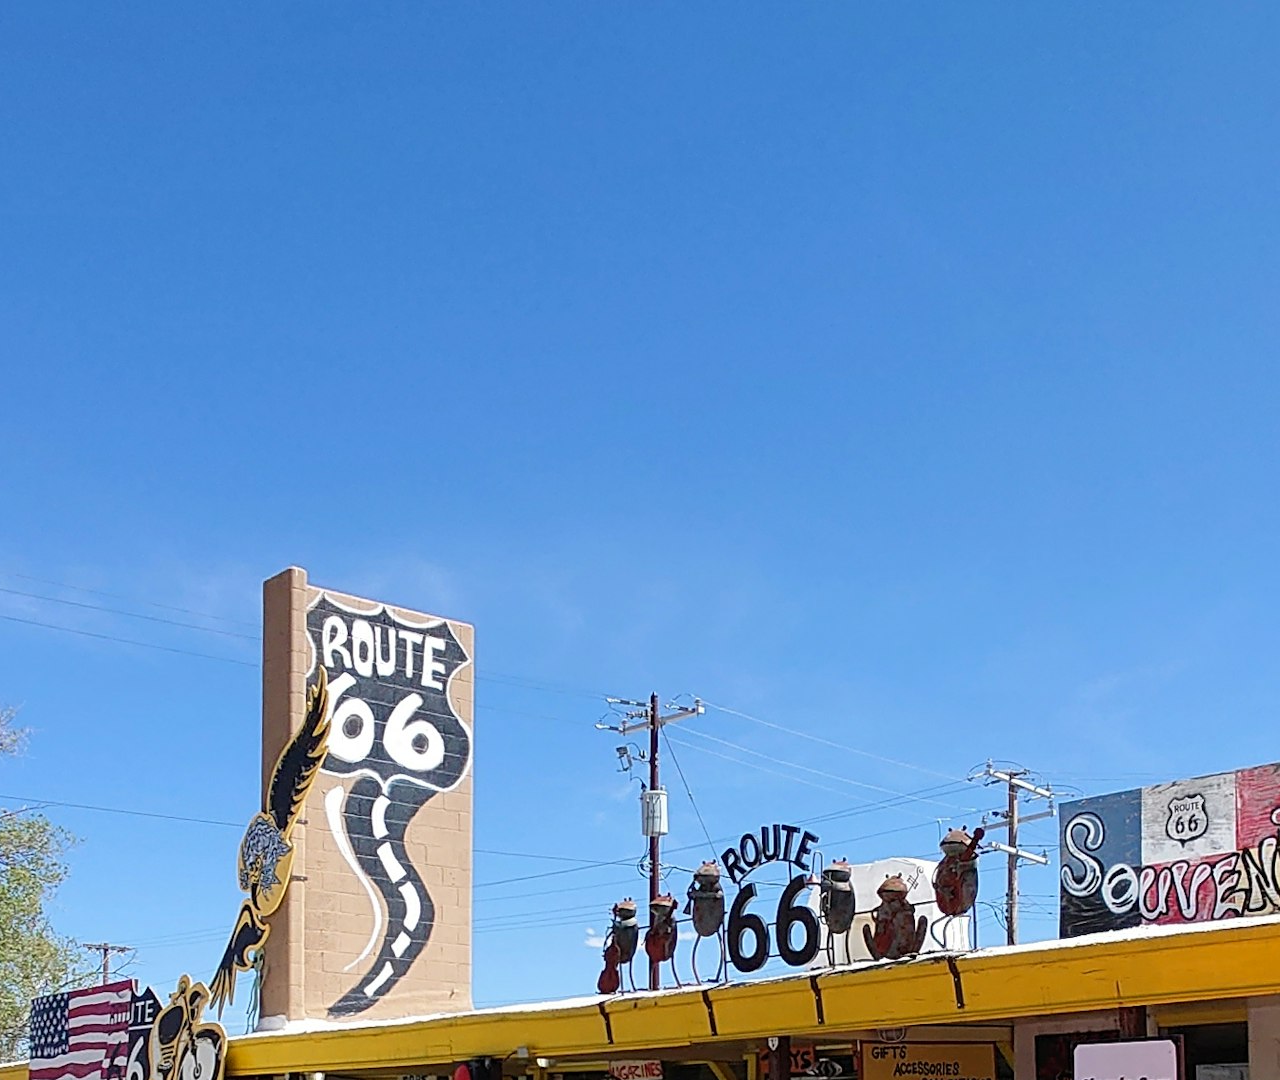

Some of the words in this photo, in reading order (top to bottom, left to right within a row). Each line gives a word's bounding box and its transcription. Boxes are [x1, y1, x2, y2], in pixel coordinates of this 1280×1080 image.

[322, 614, 446, 691] ROUTE
[325, 671, 446, 771] 66
[1174, 801, 1200, 813] ROUTE
[1176, 814, 1199, 834] 66
[720, 824, 820, 884] ROUTE
[727, 874, 820, 973] 66
[872, 1046, 907, 1059] GIFTS
[894, 1062, 960, 1077] ACCESSORIES
